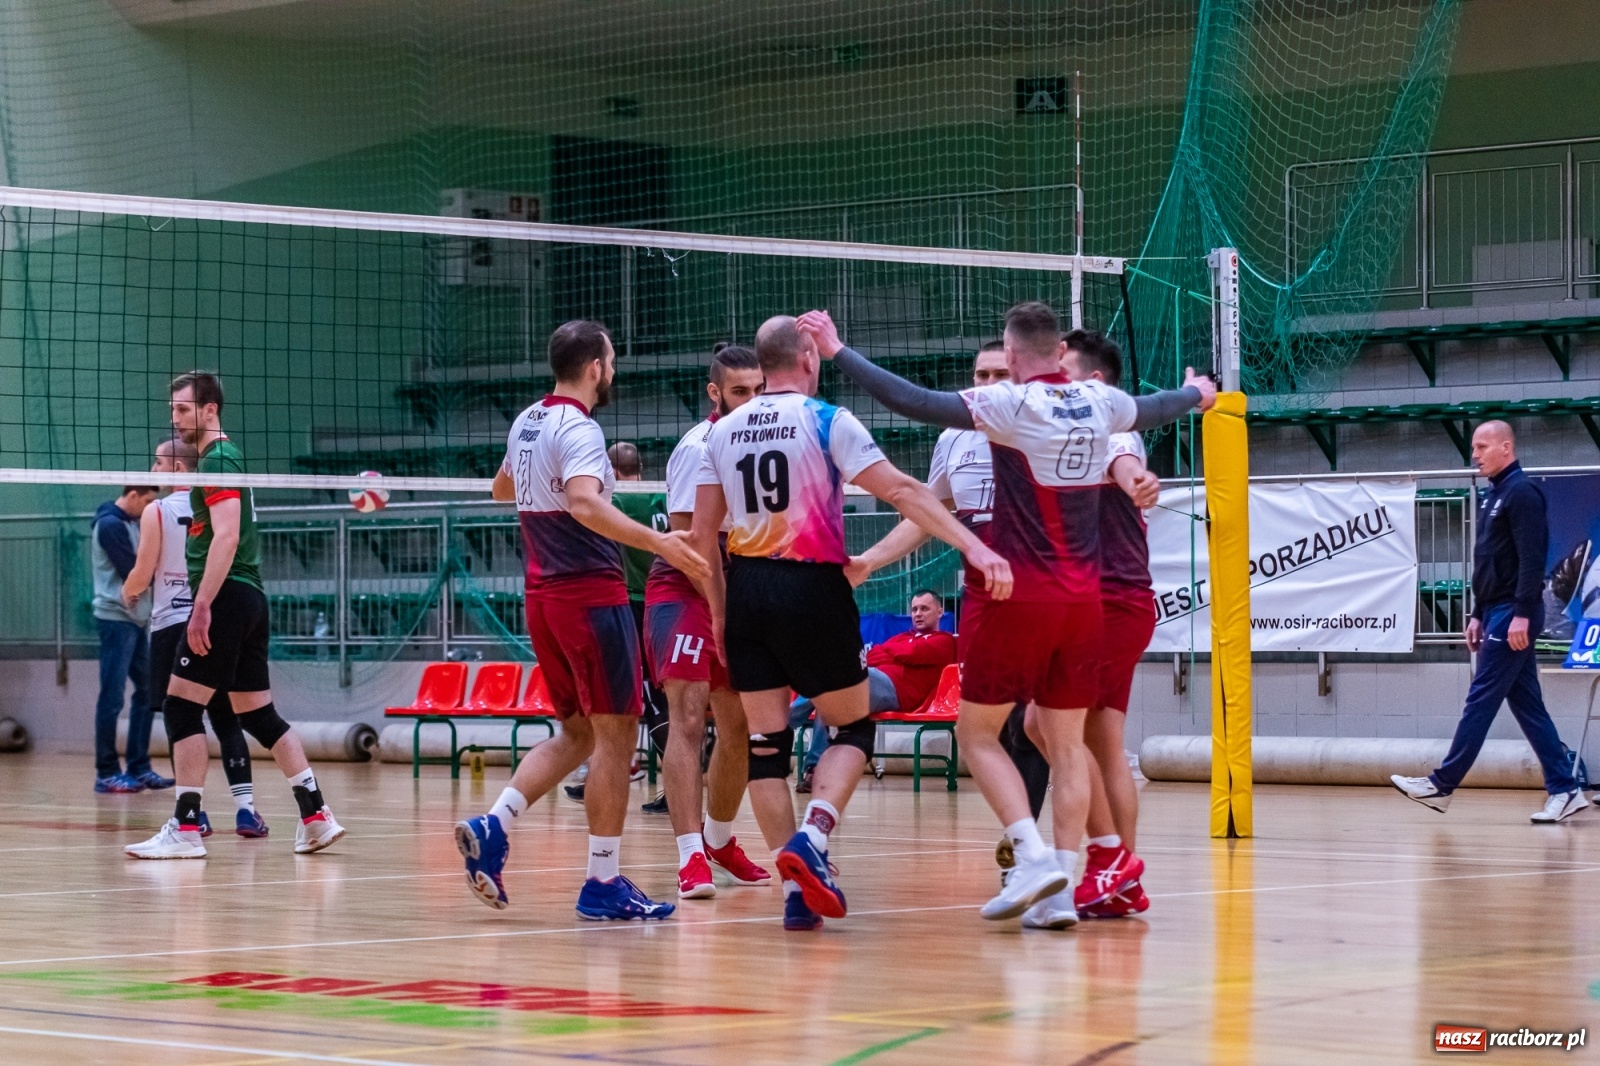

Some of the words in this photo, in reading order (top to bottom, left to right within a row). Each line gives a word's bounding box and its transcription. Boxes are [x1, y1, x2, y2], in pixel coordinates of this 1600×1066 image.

[730, 426, 797, 446] PYSKOWICE
[1055, 426, 1095, 481] 8
[735, 449, 790, 515] 19
[1153, 579, 1207, 624] JEST
[670, 633, 705, 665] 14
[1584, 624, 1600, 647] 0
